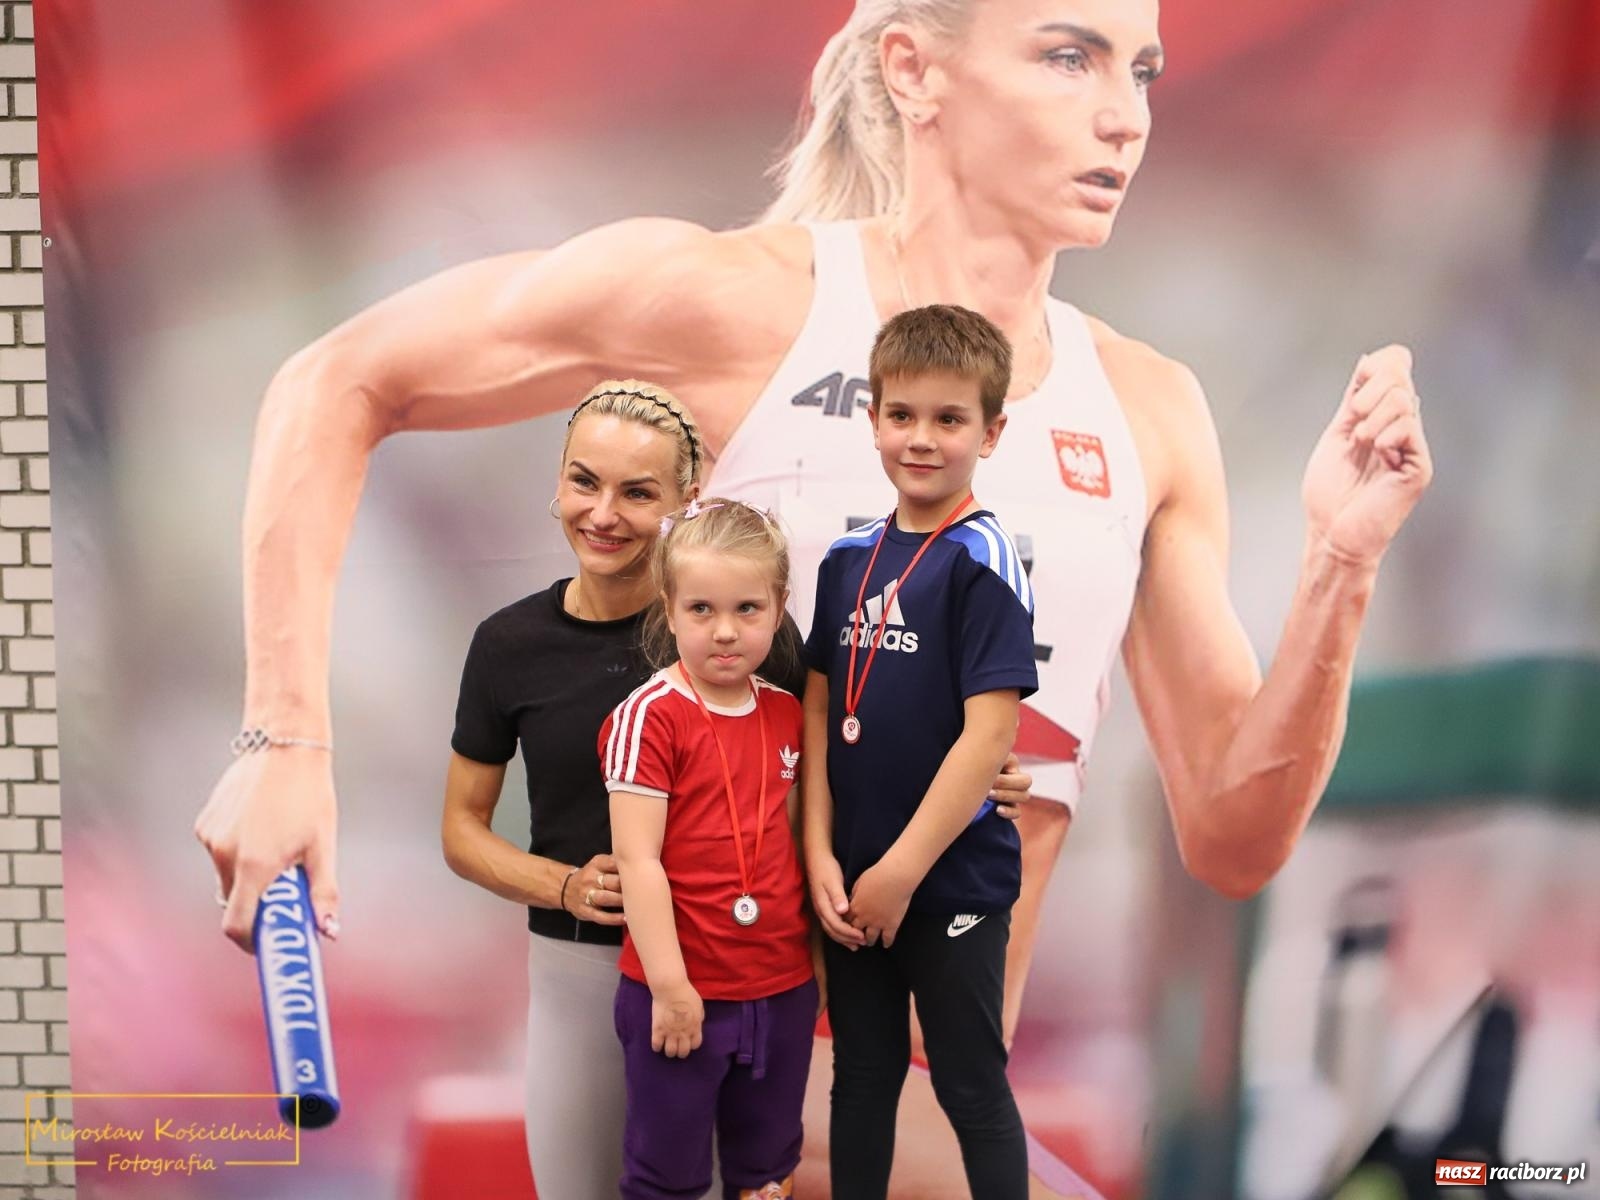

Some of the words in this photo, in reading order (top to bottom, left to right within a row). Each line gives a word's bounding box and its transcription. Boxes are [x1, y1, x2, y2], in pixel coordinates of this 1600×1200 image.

[840, 622, 919, 653] adidas
[953, 914, 978, 926] NIKE
[296, 1059, 317, 1084] 3
